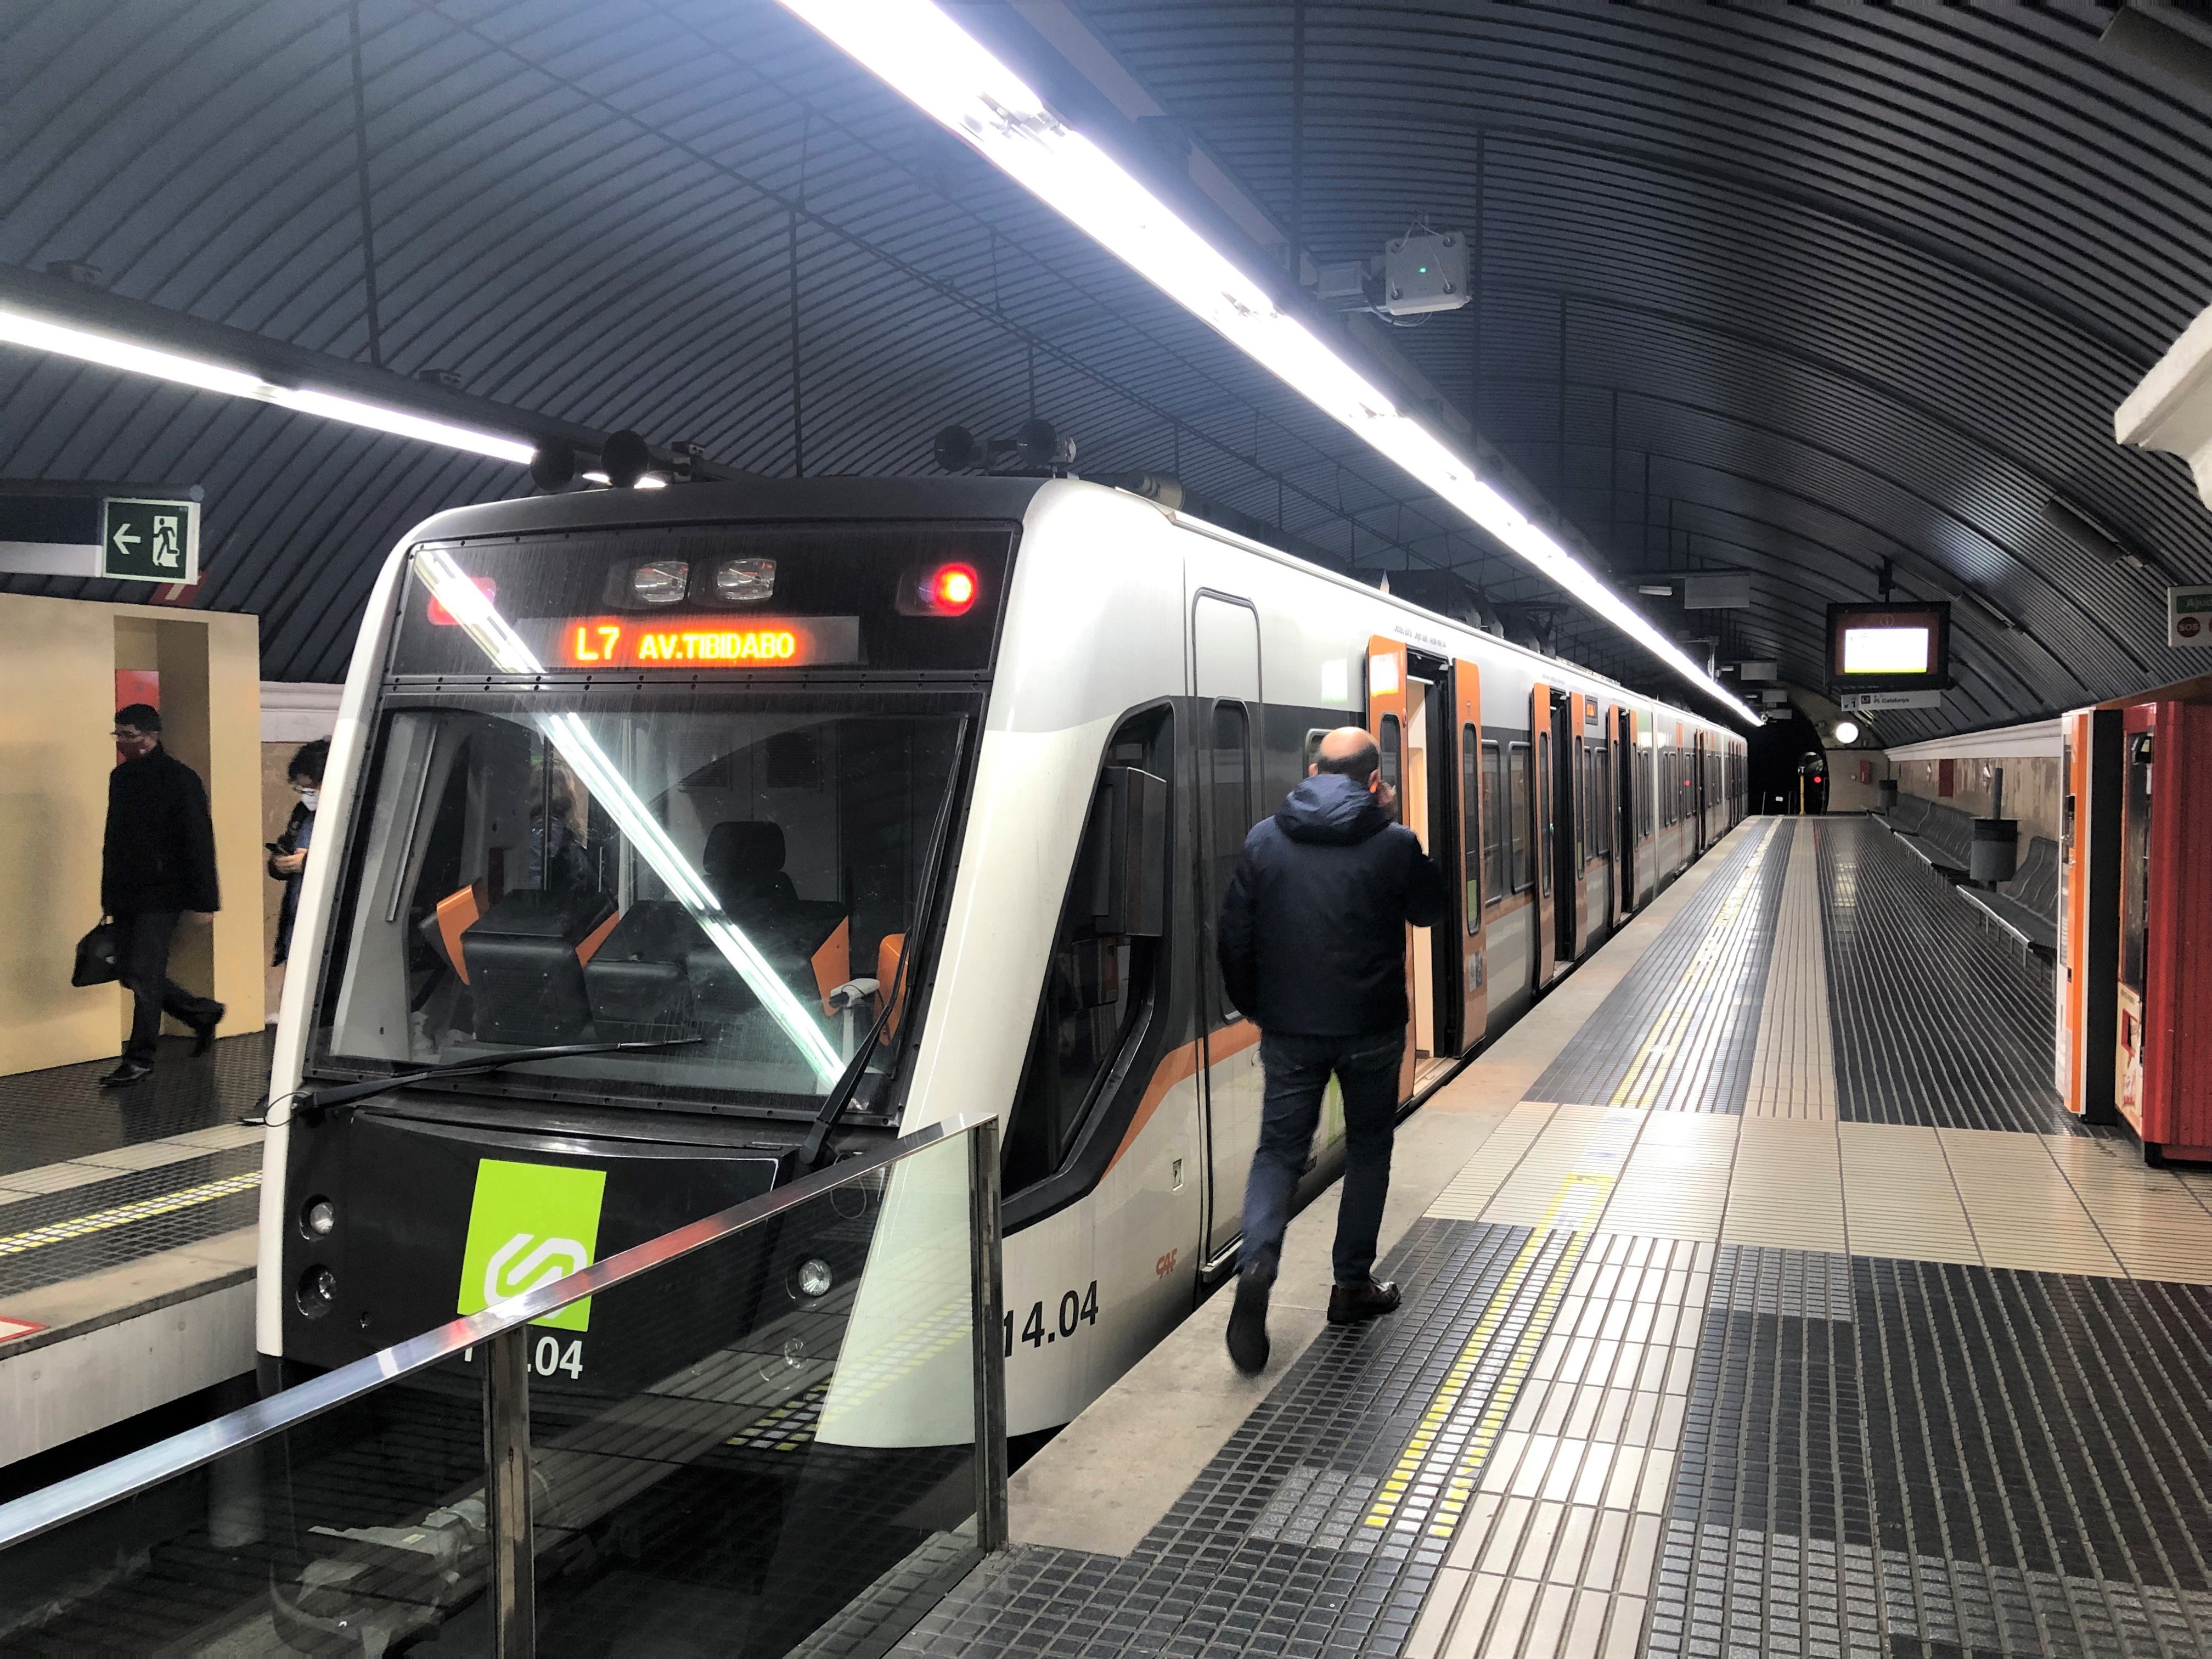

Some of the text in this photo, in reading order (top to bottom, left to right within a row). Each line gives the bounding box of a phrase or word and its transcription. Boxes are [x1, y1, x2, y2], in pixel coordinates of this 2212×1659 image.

[576, 626, 795, 661] L7 AV.TIBIDABO
[2178, 623, 2199, 631] SOS
[1004, 1280, 1099, 1358] 14.04
